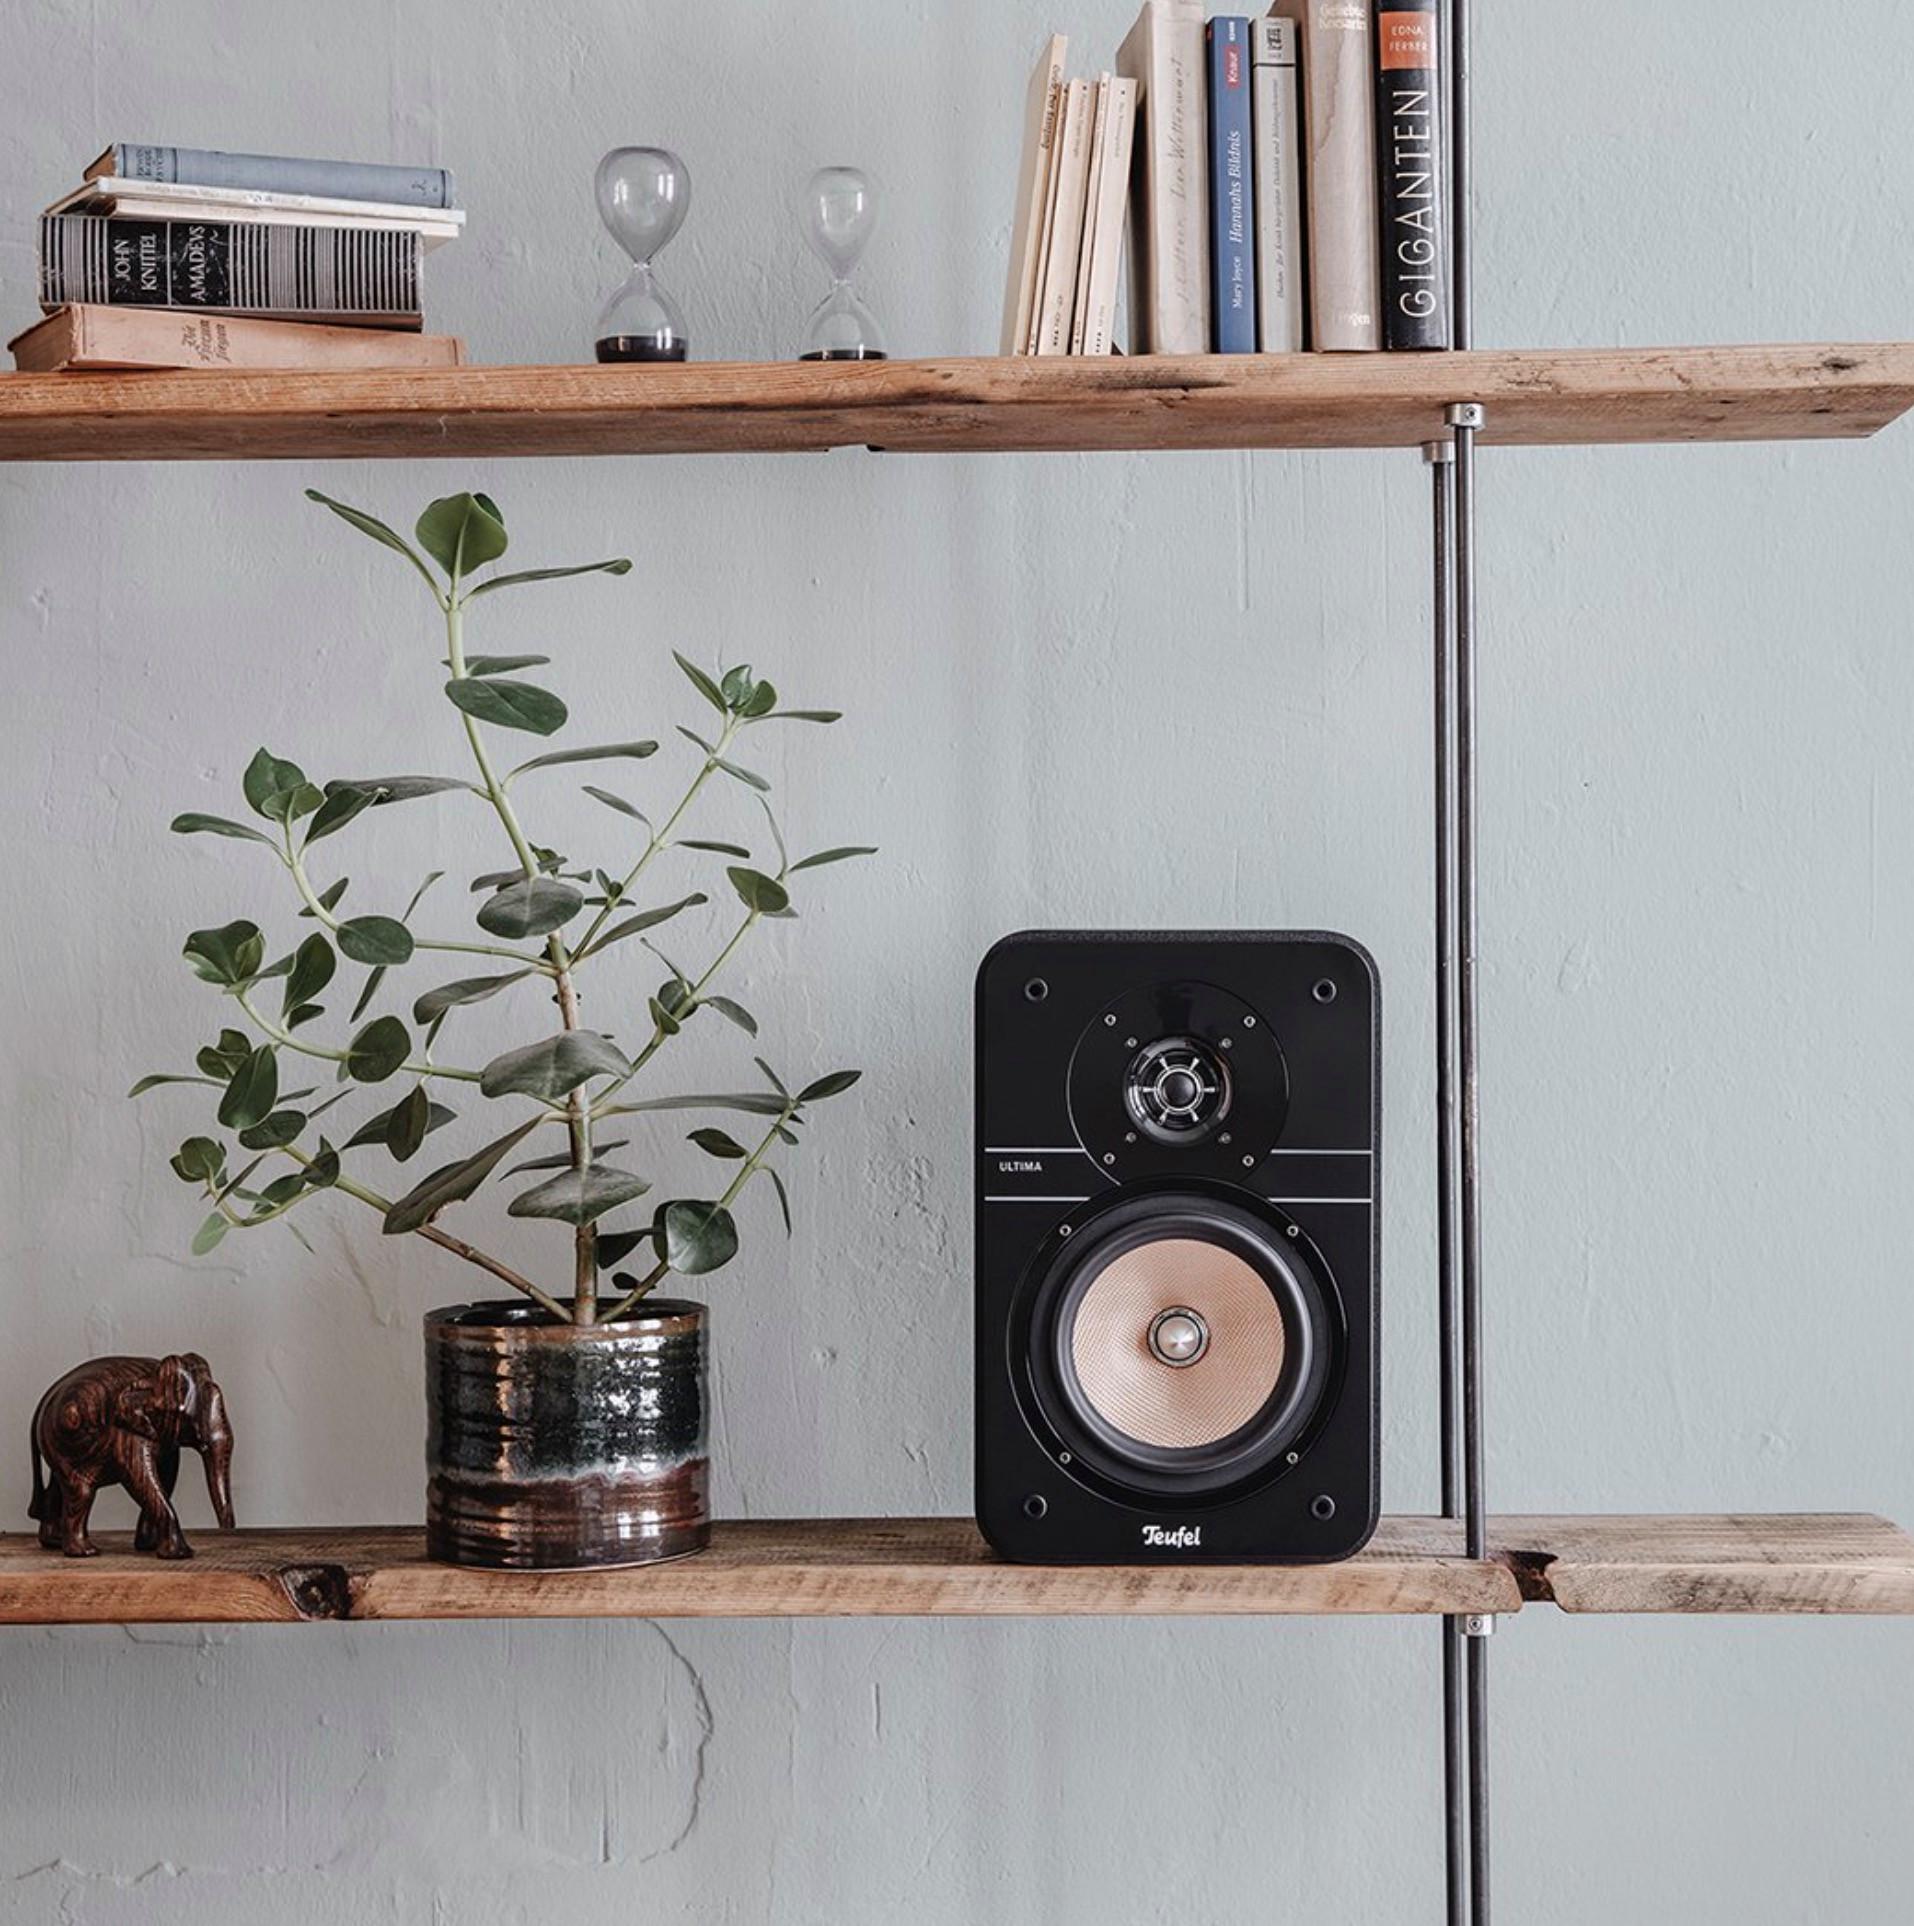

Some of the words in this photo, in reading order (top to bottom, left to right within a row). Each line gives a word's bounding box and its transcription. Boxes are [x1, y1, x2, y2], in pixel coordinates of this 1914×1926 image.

[1388, 41, 1429, 52] FERBER
[1390, 25, 1423, 36] EDNA
[1227, 51, 1239, 84] Knaur
[1227, 130, 1242, 179] Bildnis
[1229, 181, 1244, 244] Hannahs
[1393, 89, 1436, 319] GIGANTEN
[113, 239, 130, 281] JOHN
[141, 231, 159, 292] KNITTEL
[189, 224, 207, 302] AMADEVS
[1232, 284, 1245, 310] Mary
[999, 1160, 1043, 1173] ULTIMA
[1142, 1525, 1202, 1548] Teufel
